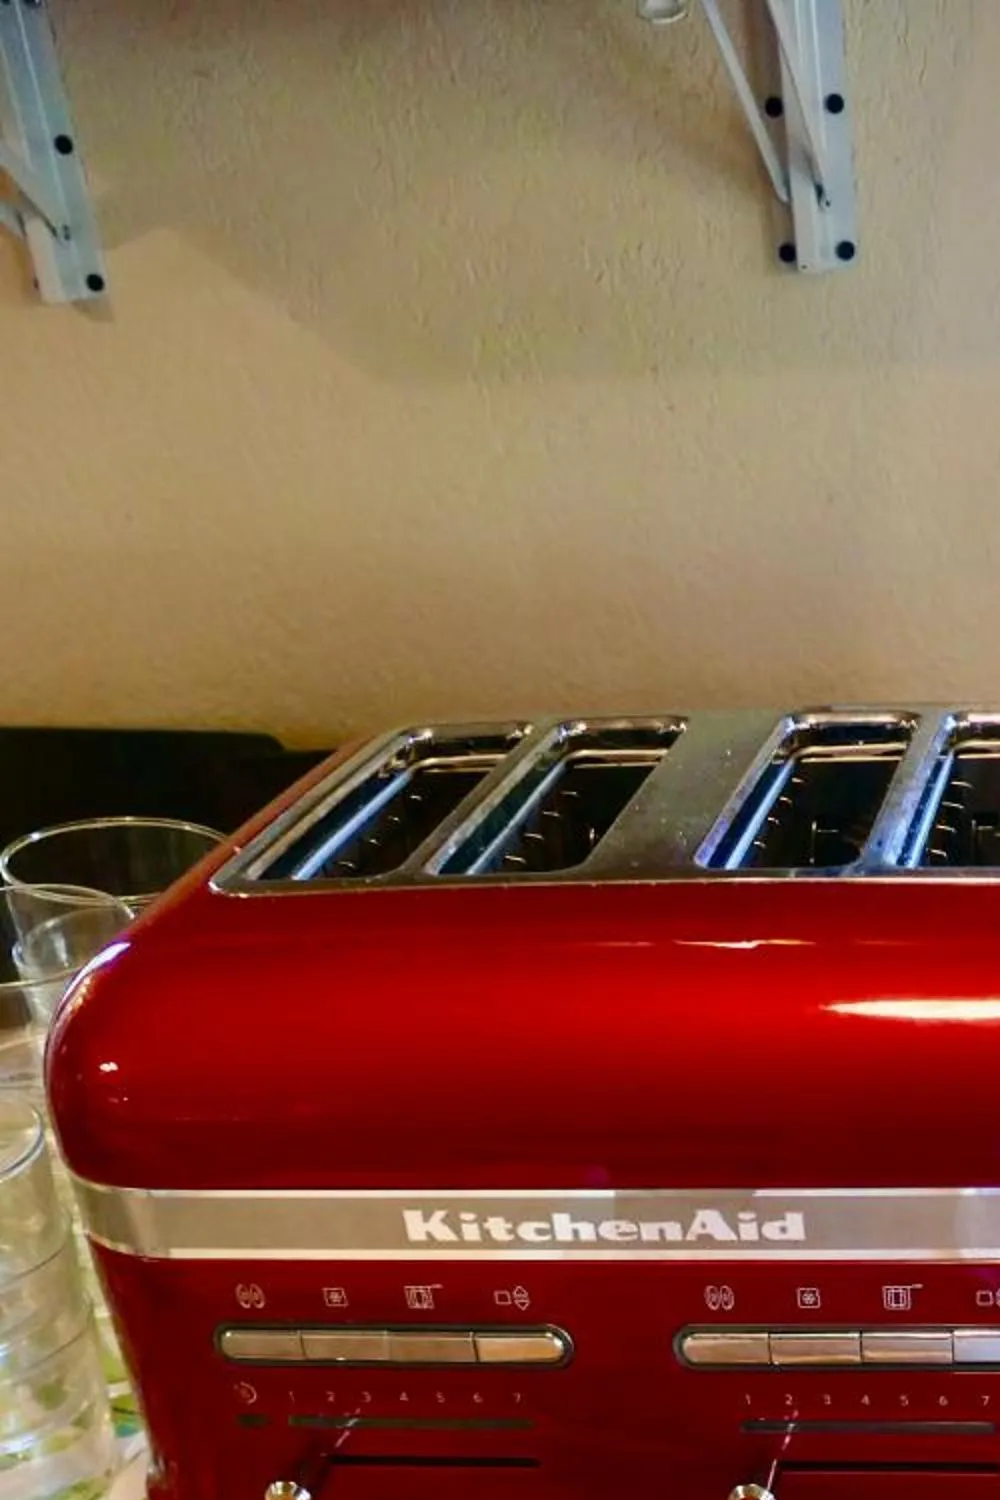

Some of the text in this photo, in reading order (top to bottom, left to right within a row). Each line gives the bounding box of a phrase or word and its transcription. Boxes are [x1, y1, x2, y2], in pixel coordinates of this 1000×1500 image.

[402, 1209, 806, 1242] KitchenAid
[326, 1390, 336, 1403] 2
[361, 1390, 372, 1403] 3
[399, 1390, 409, 1402] 4
[435, 1390, 446, 1404] 5
[472, 1391, 483, 1404] 6
[784, 1393, 794, 1406] 2
[823, 1393, 832, 1406] 3
[860, 1393, 870, 1406] 4
[900, 1393, 909, 1407] 5
[938, 1393, 948, 1406] 6
[981, 1394, 990, 1406] 7
